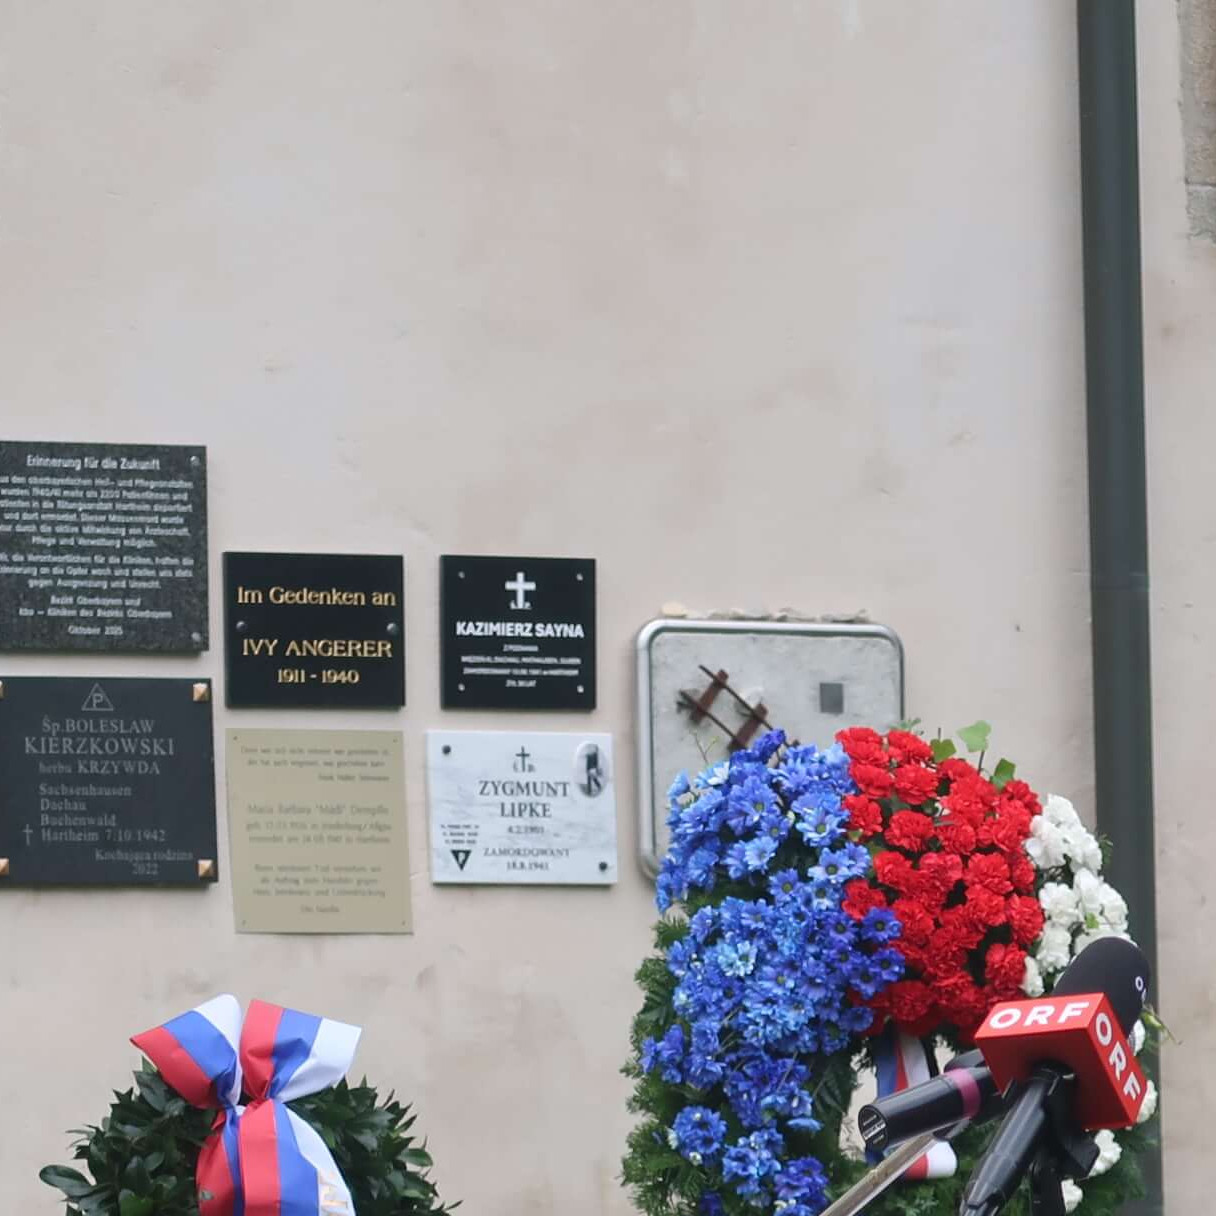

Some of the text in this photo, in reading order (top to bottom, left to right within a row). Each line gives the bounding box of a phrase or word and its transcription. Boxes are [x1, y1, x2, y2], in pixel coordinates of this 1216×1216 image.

[27, 454, 160, 471] Erinnerung für die Zukunft
[237, 586, 396, 606] Im Gedenken an
[456, 621, 584, 638] KAZIMIERZ SAYNA
[242, 639, 392, 658] IVY ANGERER
[277, 668, 305, 683] 1911
[321, 670, 359, 684] 1940
[92, 694, 103, 709] P
[24, 736, 174, 756] KIERZKOWSKI
[78, 759, 160, 775] KRZYWDA
[39, 783, 133, 796] Sachsenhausen
[478, 780, 570, 797] ZYGMUNT
[40, 798, 87, 811] Dachau
[500, 802, 552, 818] LIPKE
[40, 813, 117, 826] Buchenwald
[41, 827, 100, 841] Hartheim
[988, 1002, 1090, 1030] ORF
[1094, 1012, 1140, 1100] ORF
